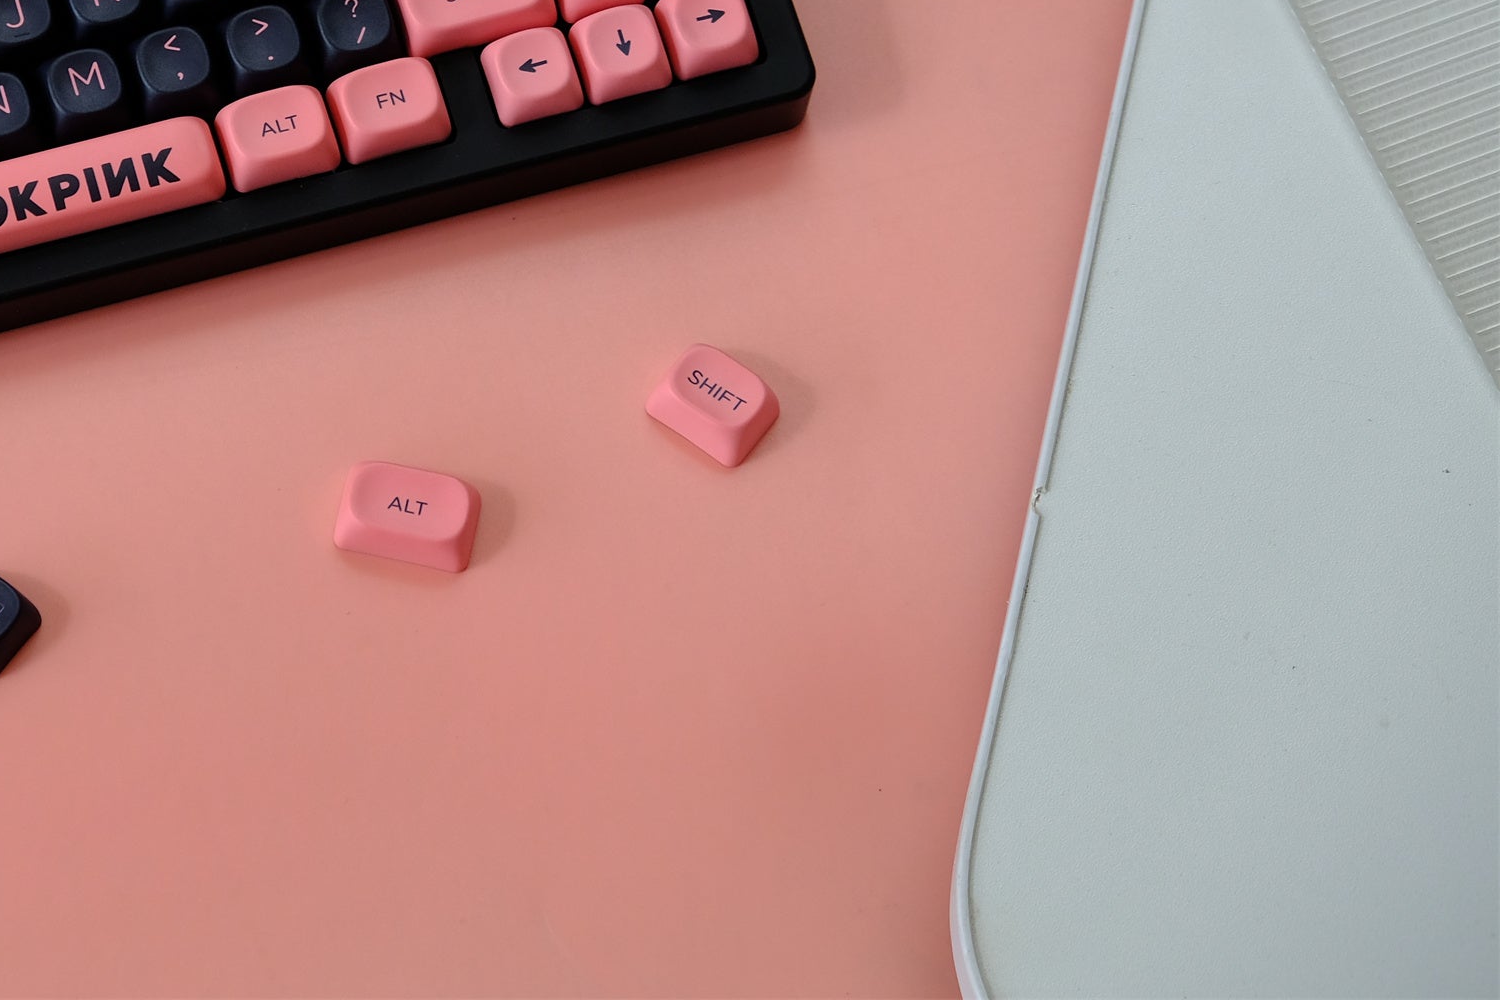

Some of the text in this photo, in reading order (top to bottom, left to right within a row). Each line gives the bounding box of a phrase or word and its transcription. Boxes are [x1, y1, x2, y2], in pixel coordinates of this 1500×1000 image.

[252, 19, 269, 36] >
[163, 34, 181, 51] <
[68, 61, 106, 96] M
[375, 89, 406, 109] FN
[261, 114, 297, 137] ALT
[687, 369, 748, 411] SHIFT
[387, 496, 428, 516] ALT
